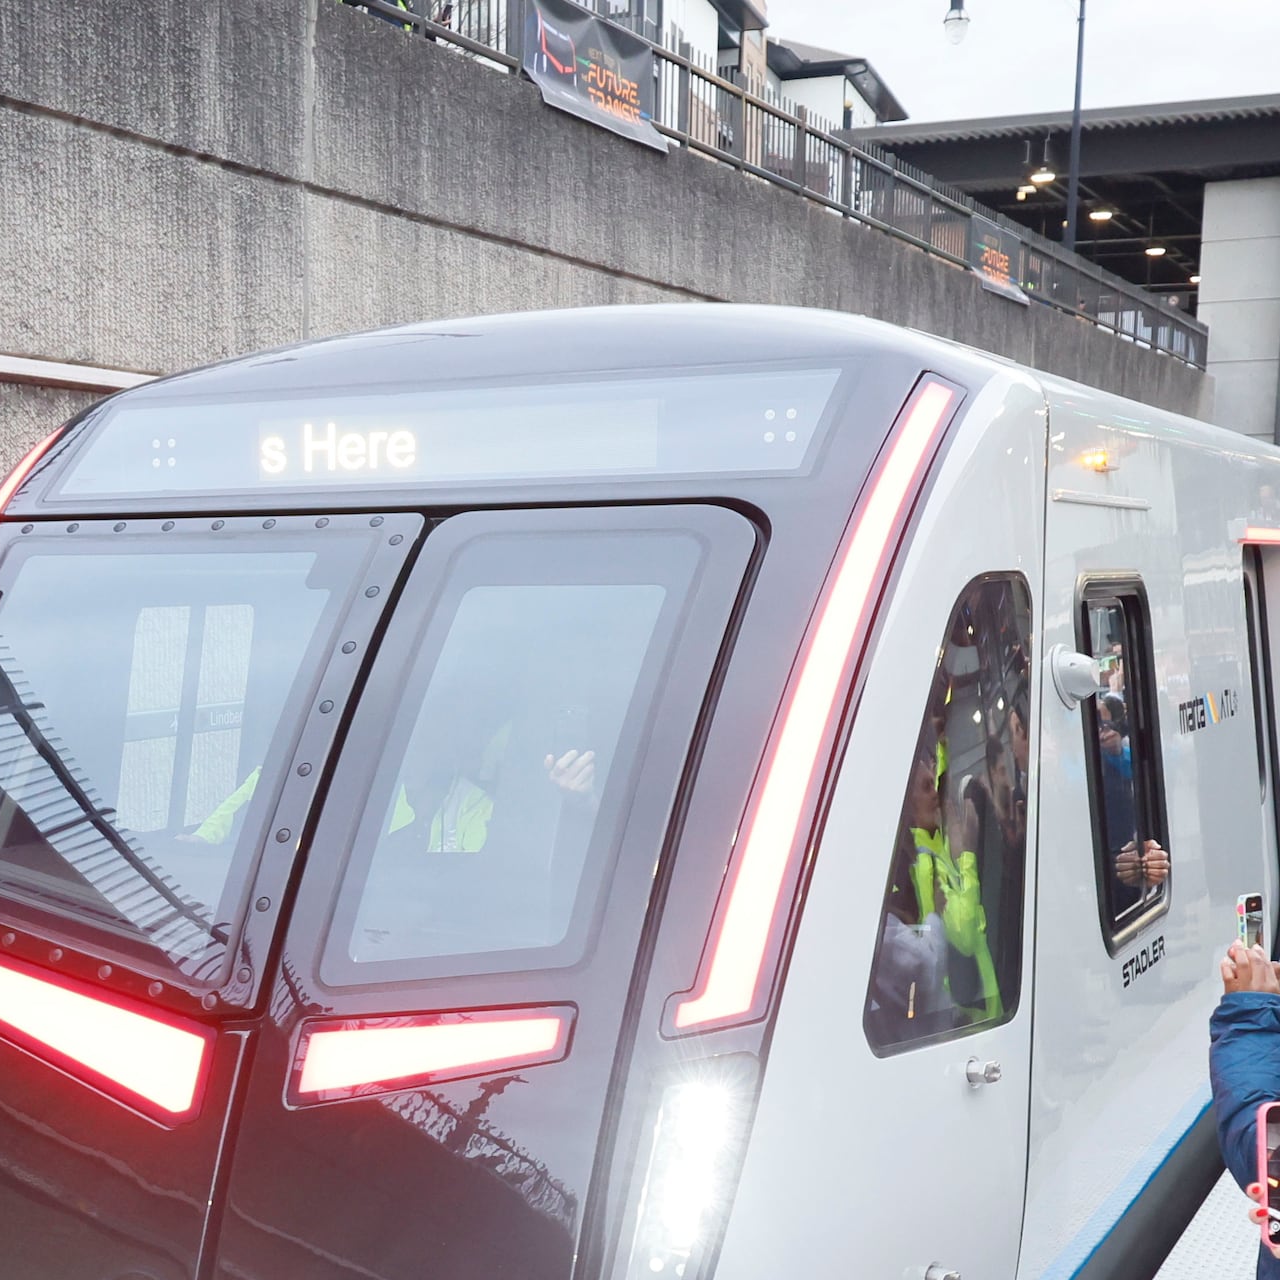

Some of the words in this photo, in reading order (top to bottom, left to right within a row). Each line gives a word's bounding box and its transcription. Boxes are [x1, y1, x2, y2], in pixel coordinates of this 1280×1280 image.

[587, 62, 639, 105] FUTURE
[587, 86, 644, 126] TRANSIT
[304, 422, 416, 472] Here
[1179, 695, 1206, 735] marta
[1122, 935, 1166, 988] STADLER
